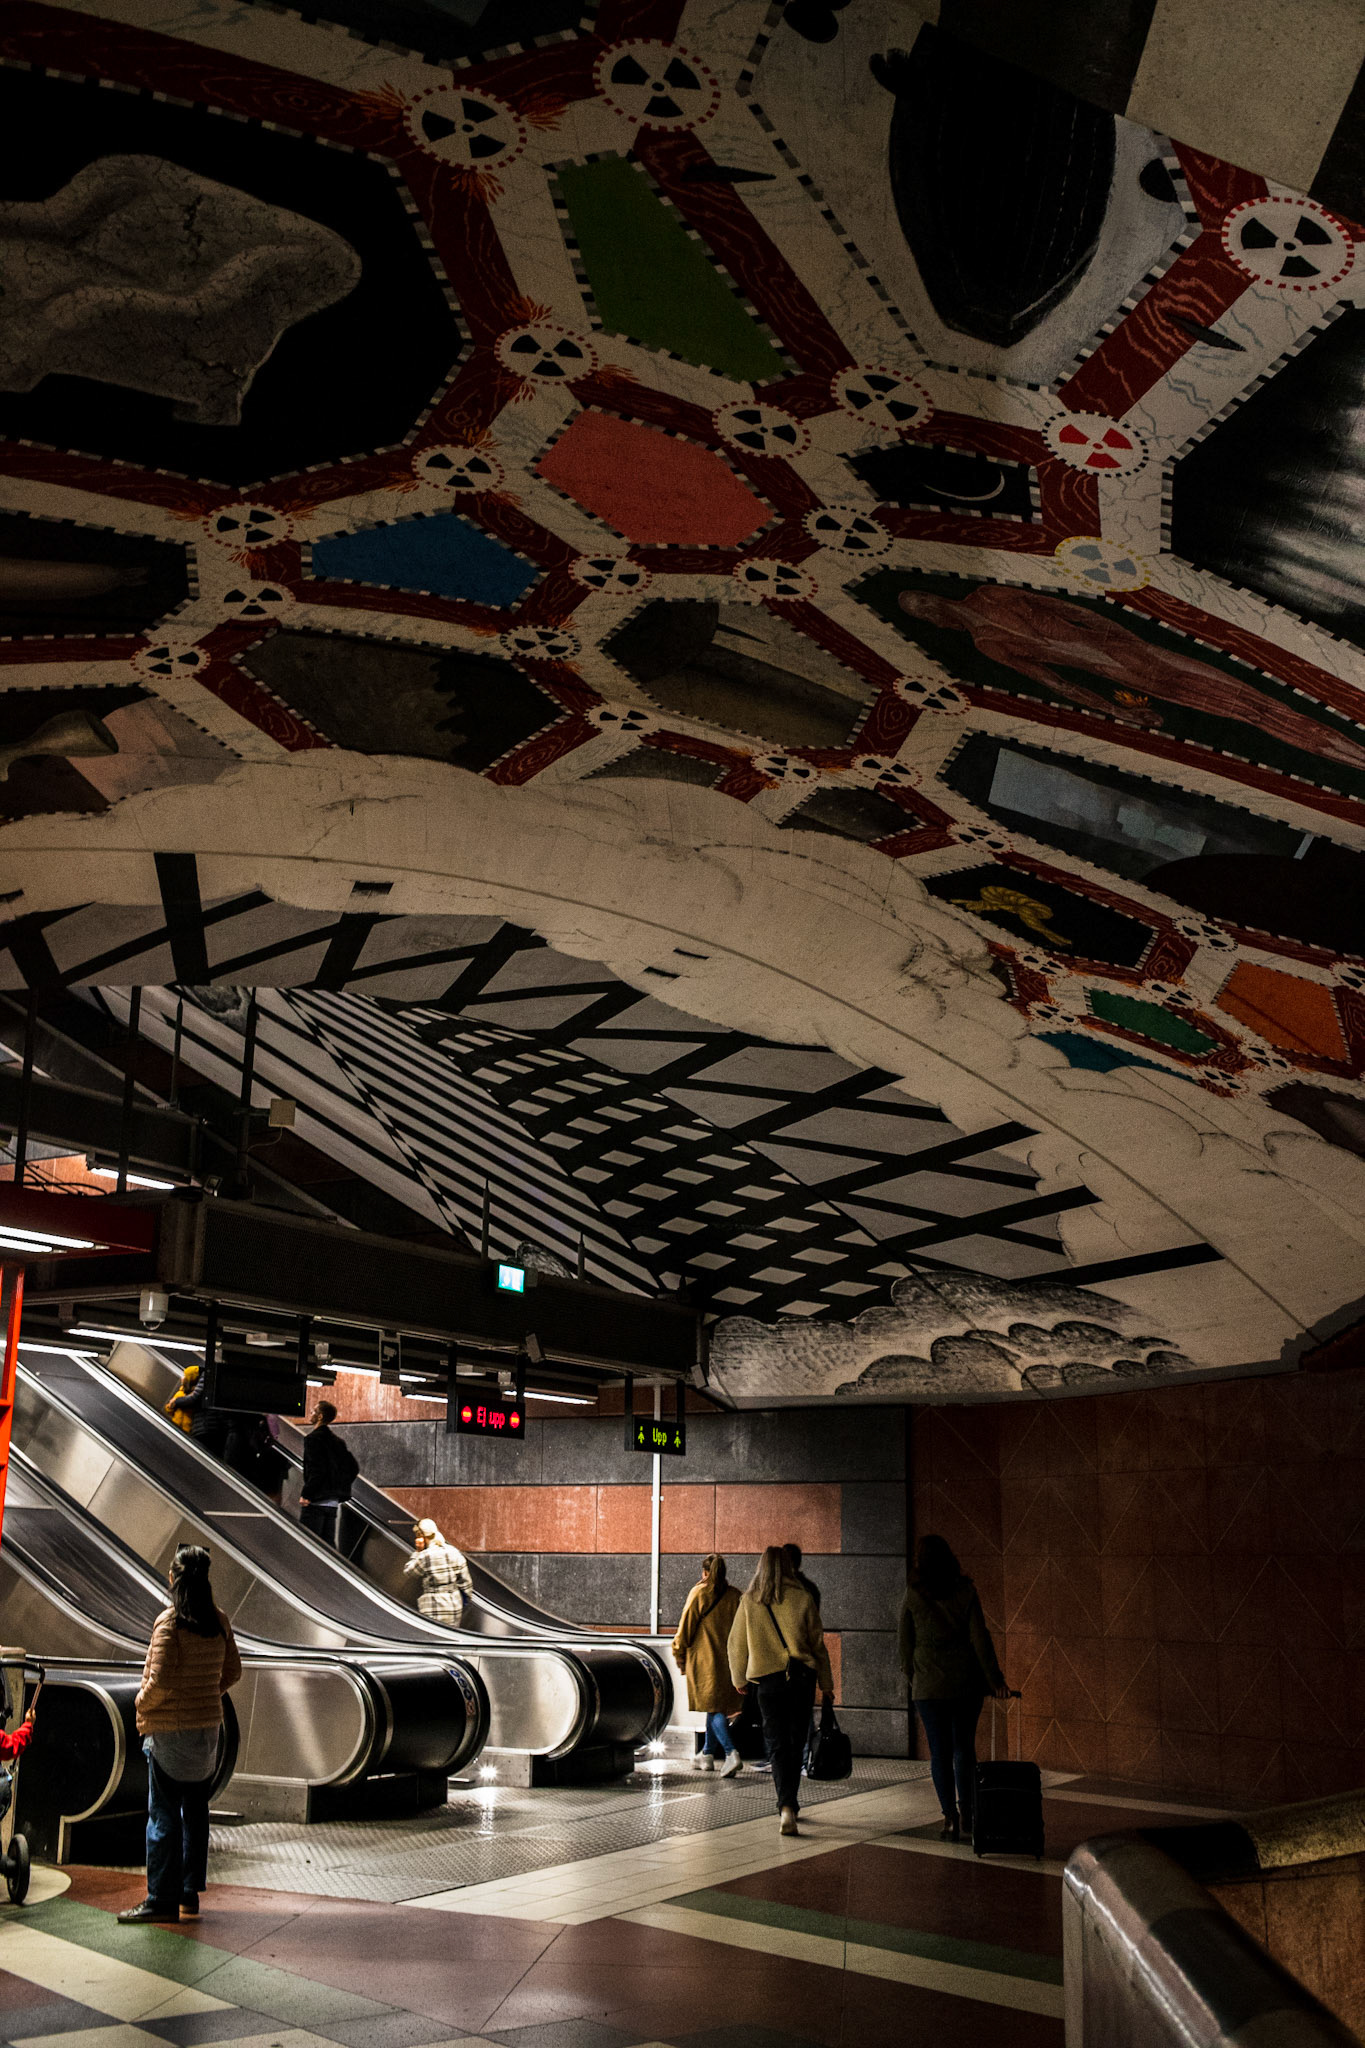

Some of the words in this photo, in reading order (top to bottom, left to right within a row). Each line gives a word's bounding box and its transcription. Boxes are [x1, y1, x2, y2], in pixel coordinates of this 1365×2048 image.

[477, 1406, 487, 1427] Ej
[489, 1411, 505, 1429] upp
[653, 1427, 667, 1446] Upp
